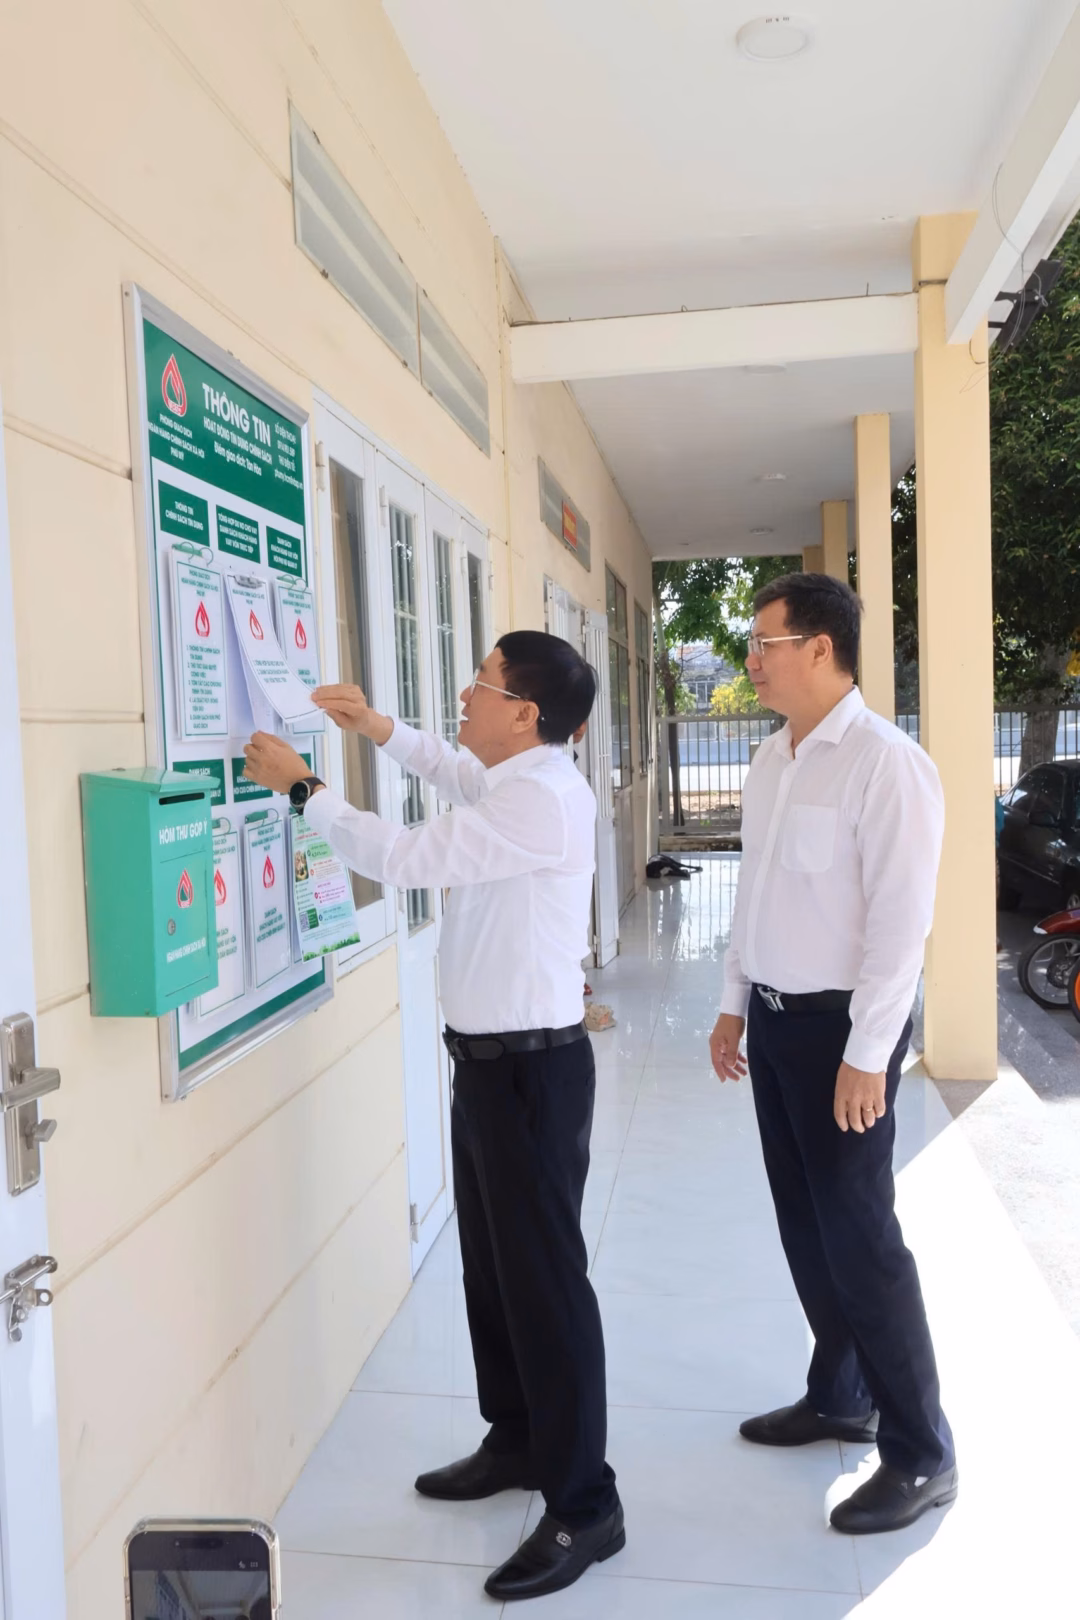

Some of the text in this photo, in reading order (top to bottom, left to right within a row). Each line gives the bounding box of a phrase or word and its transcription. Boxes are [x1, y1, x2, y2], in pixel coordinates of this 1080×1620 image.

[202, 382, 271, 447] THÔNG TIN
[159, 816, 208, 845] HÒM THƯ GÓP Ý
